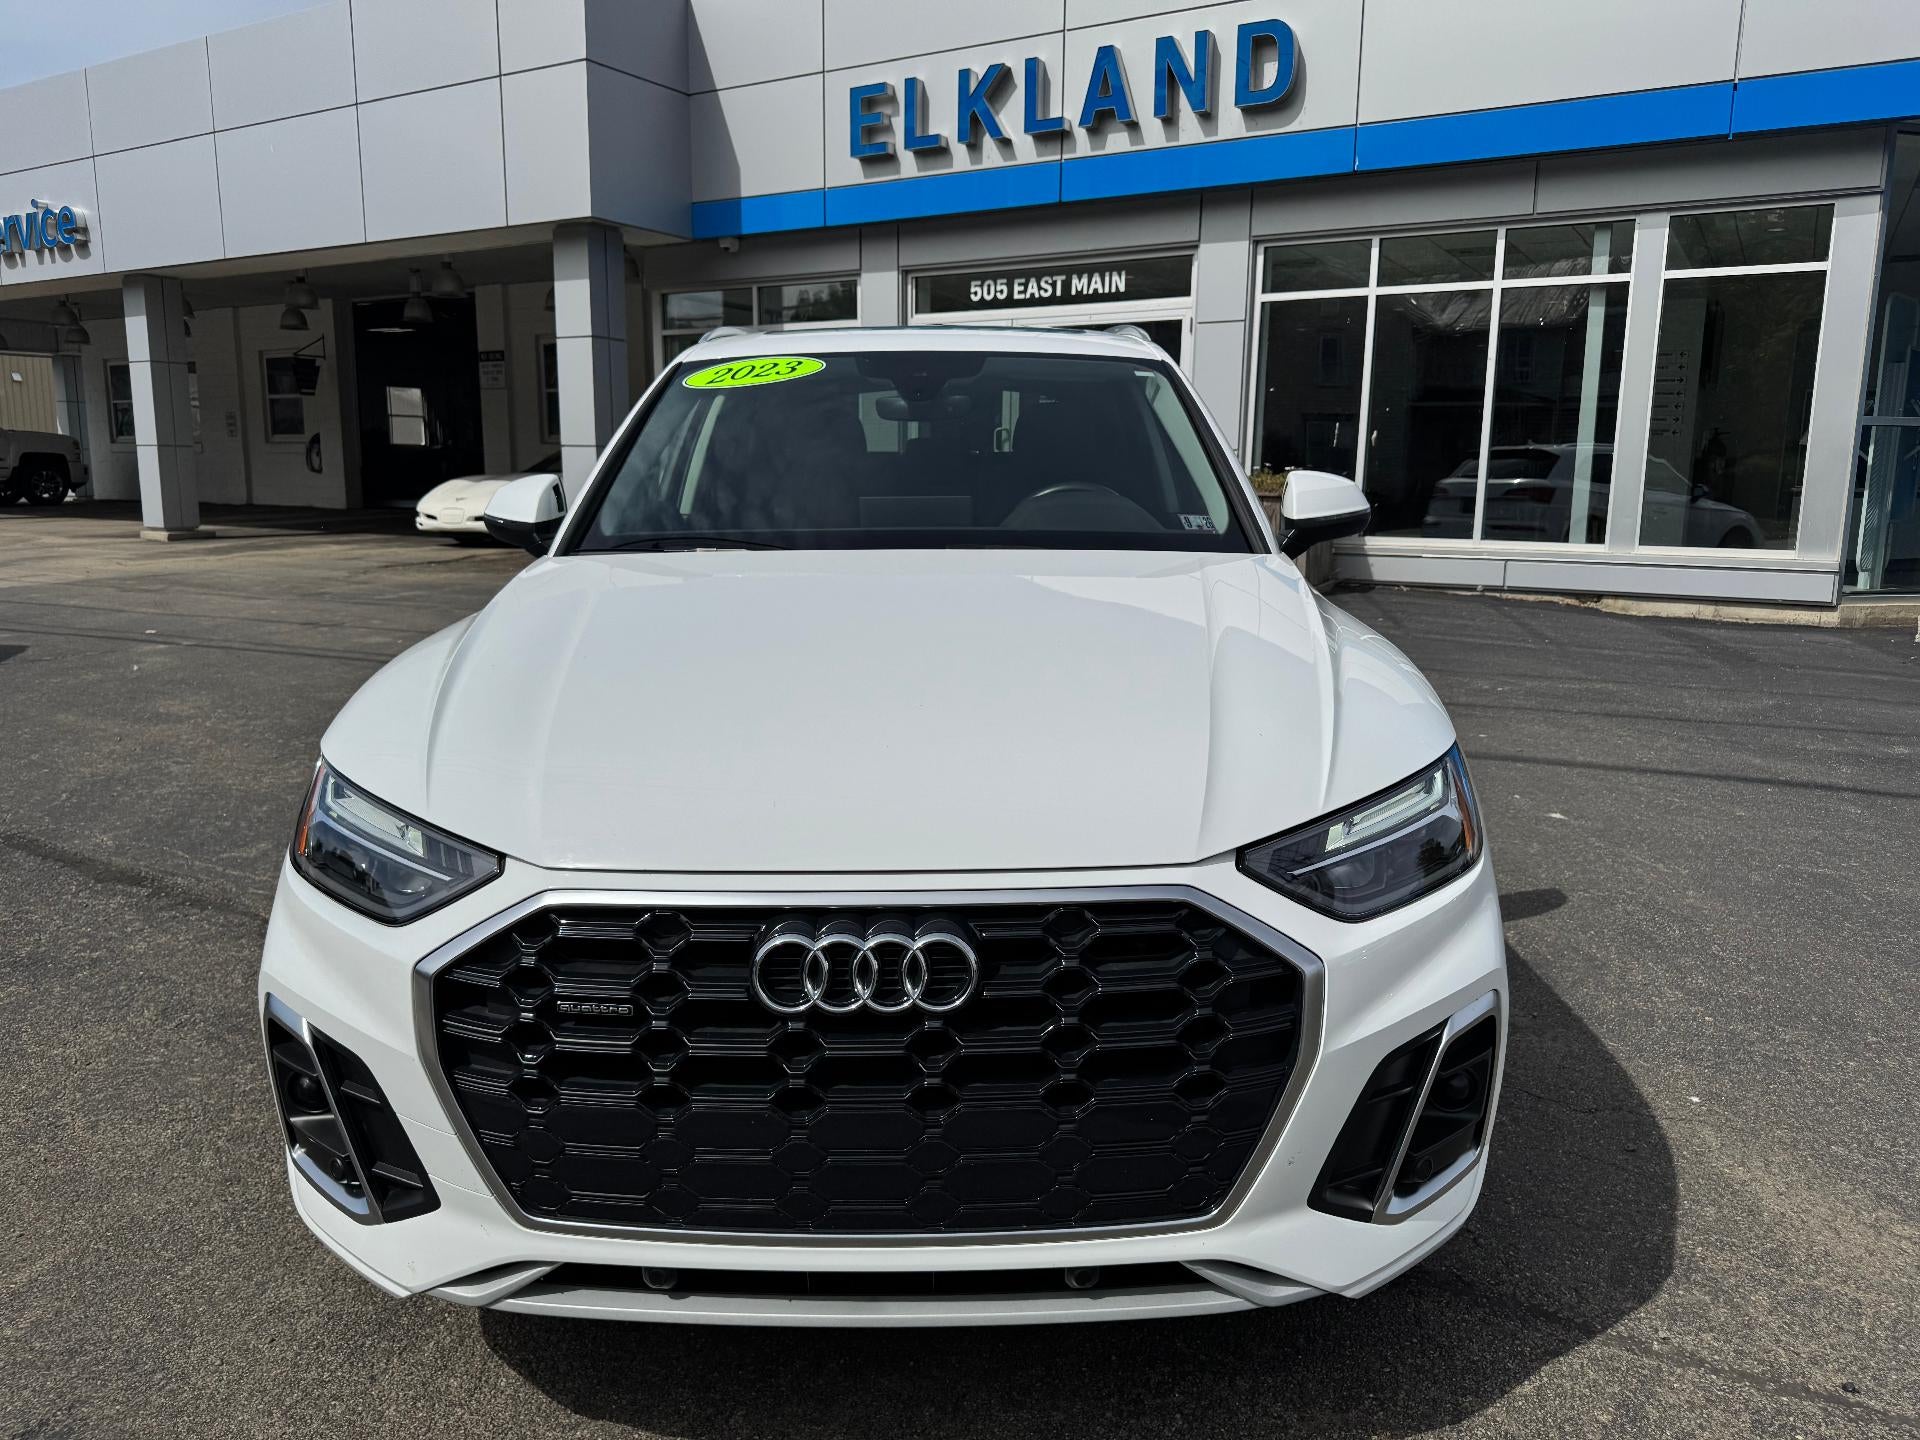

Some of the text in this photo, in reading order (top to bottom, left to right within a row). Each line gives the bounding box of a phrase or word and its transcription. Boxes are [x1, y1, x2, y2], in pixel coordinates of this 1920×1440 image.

[850, 18, 1296, 159] ELKLAND
[0, 198, 77, 254] rvice
[970, 270, 1126, 302] 505 EAST MAIN
[705, 360, 804, 386] 2023
[559, 1004, 629, 1014] quattro
